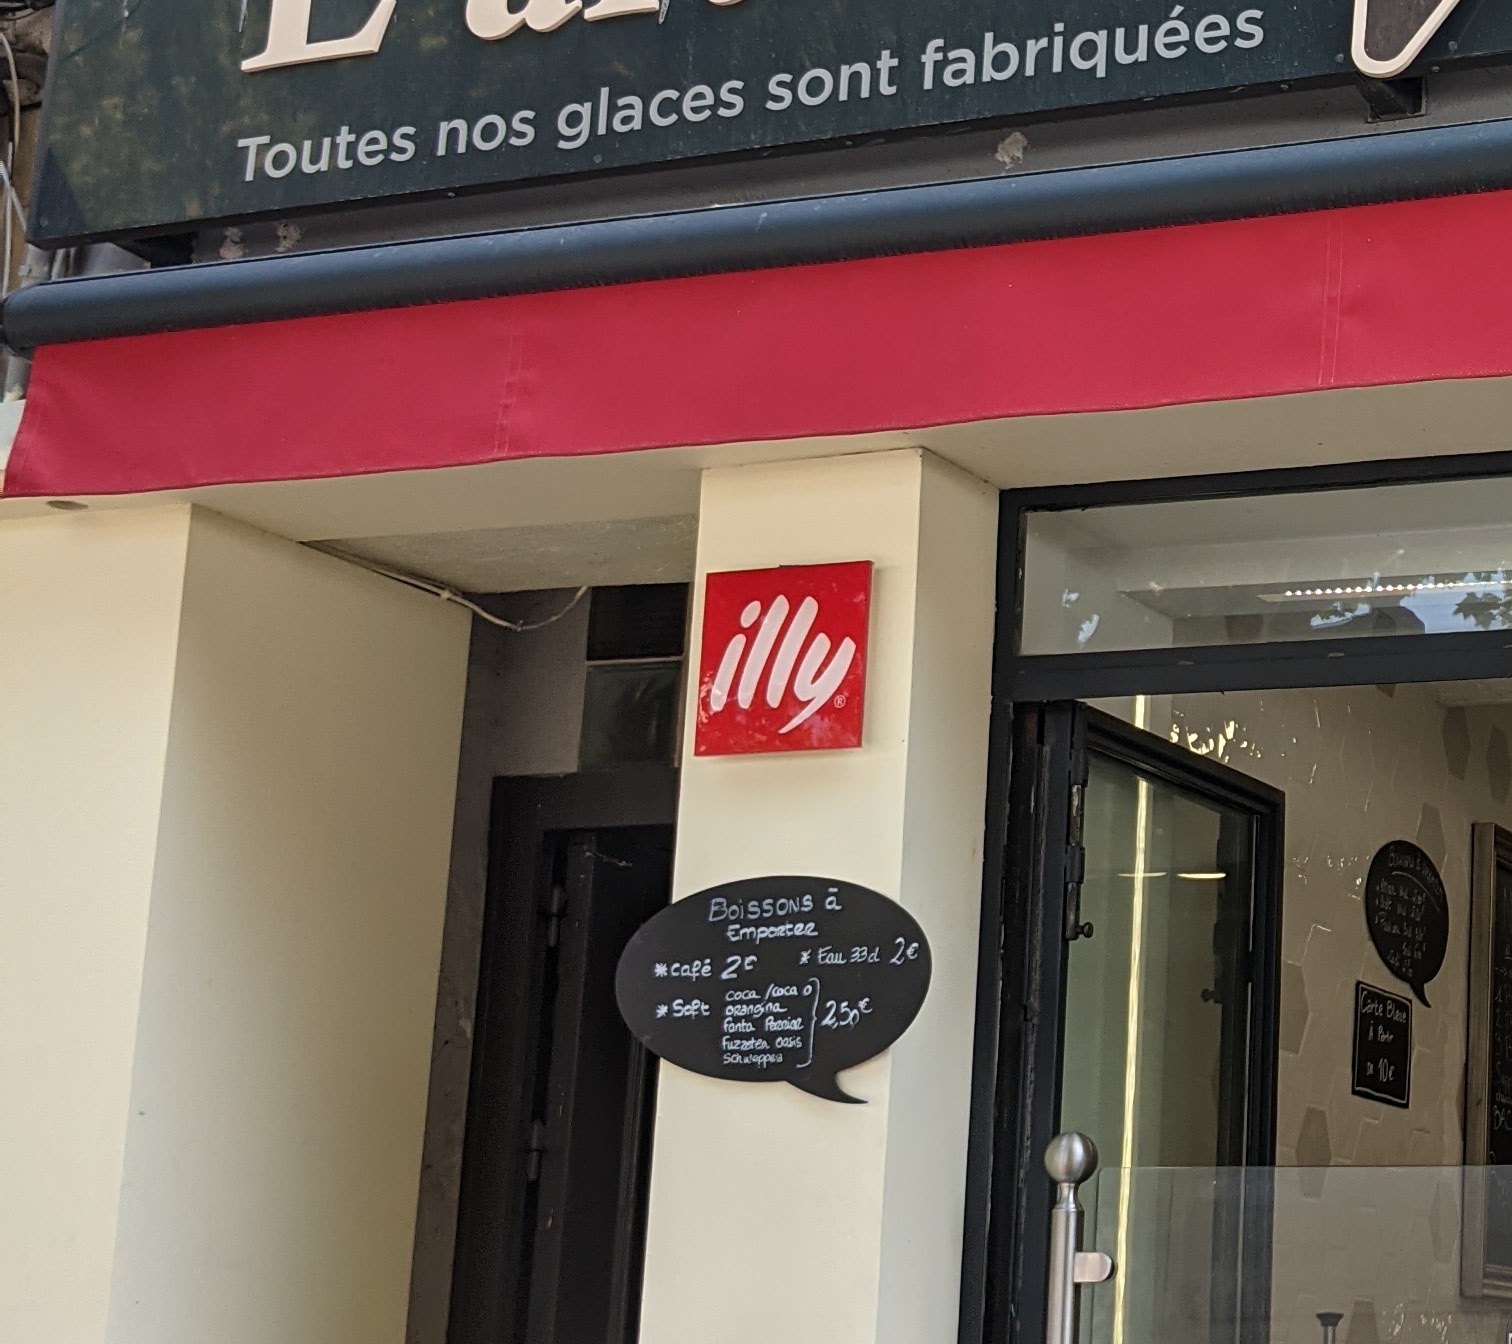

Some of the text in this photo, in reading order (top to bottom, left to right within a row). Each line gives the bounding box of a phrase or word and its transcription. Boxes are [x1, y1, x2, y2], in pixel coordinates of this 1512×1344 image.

[238, 6, 1264, 183] Toutes nos glaces sont fabriquées
[710, 594, 856, 733] illy
[726, 990, 761, 1001] coca
